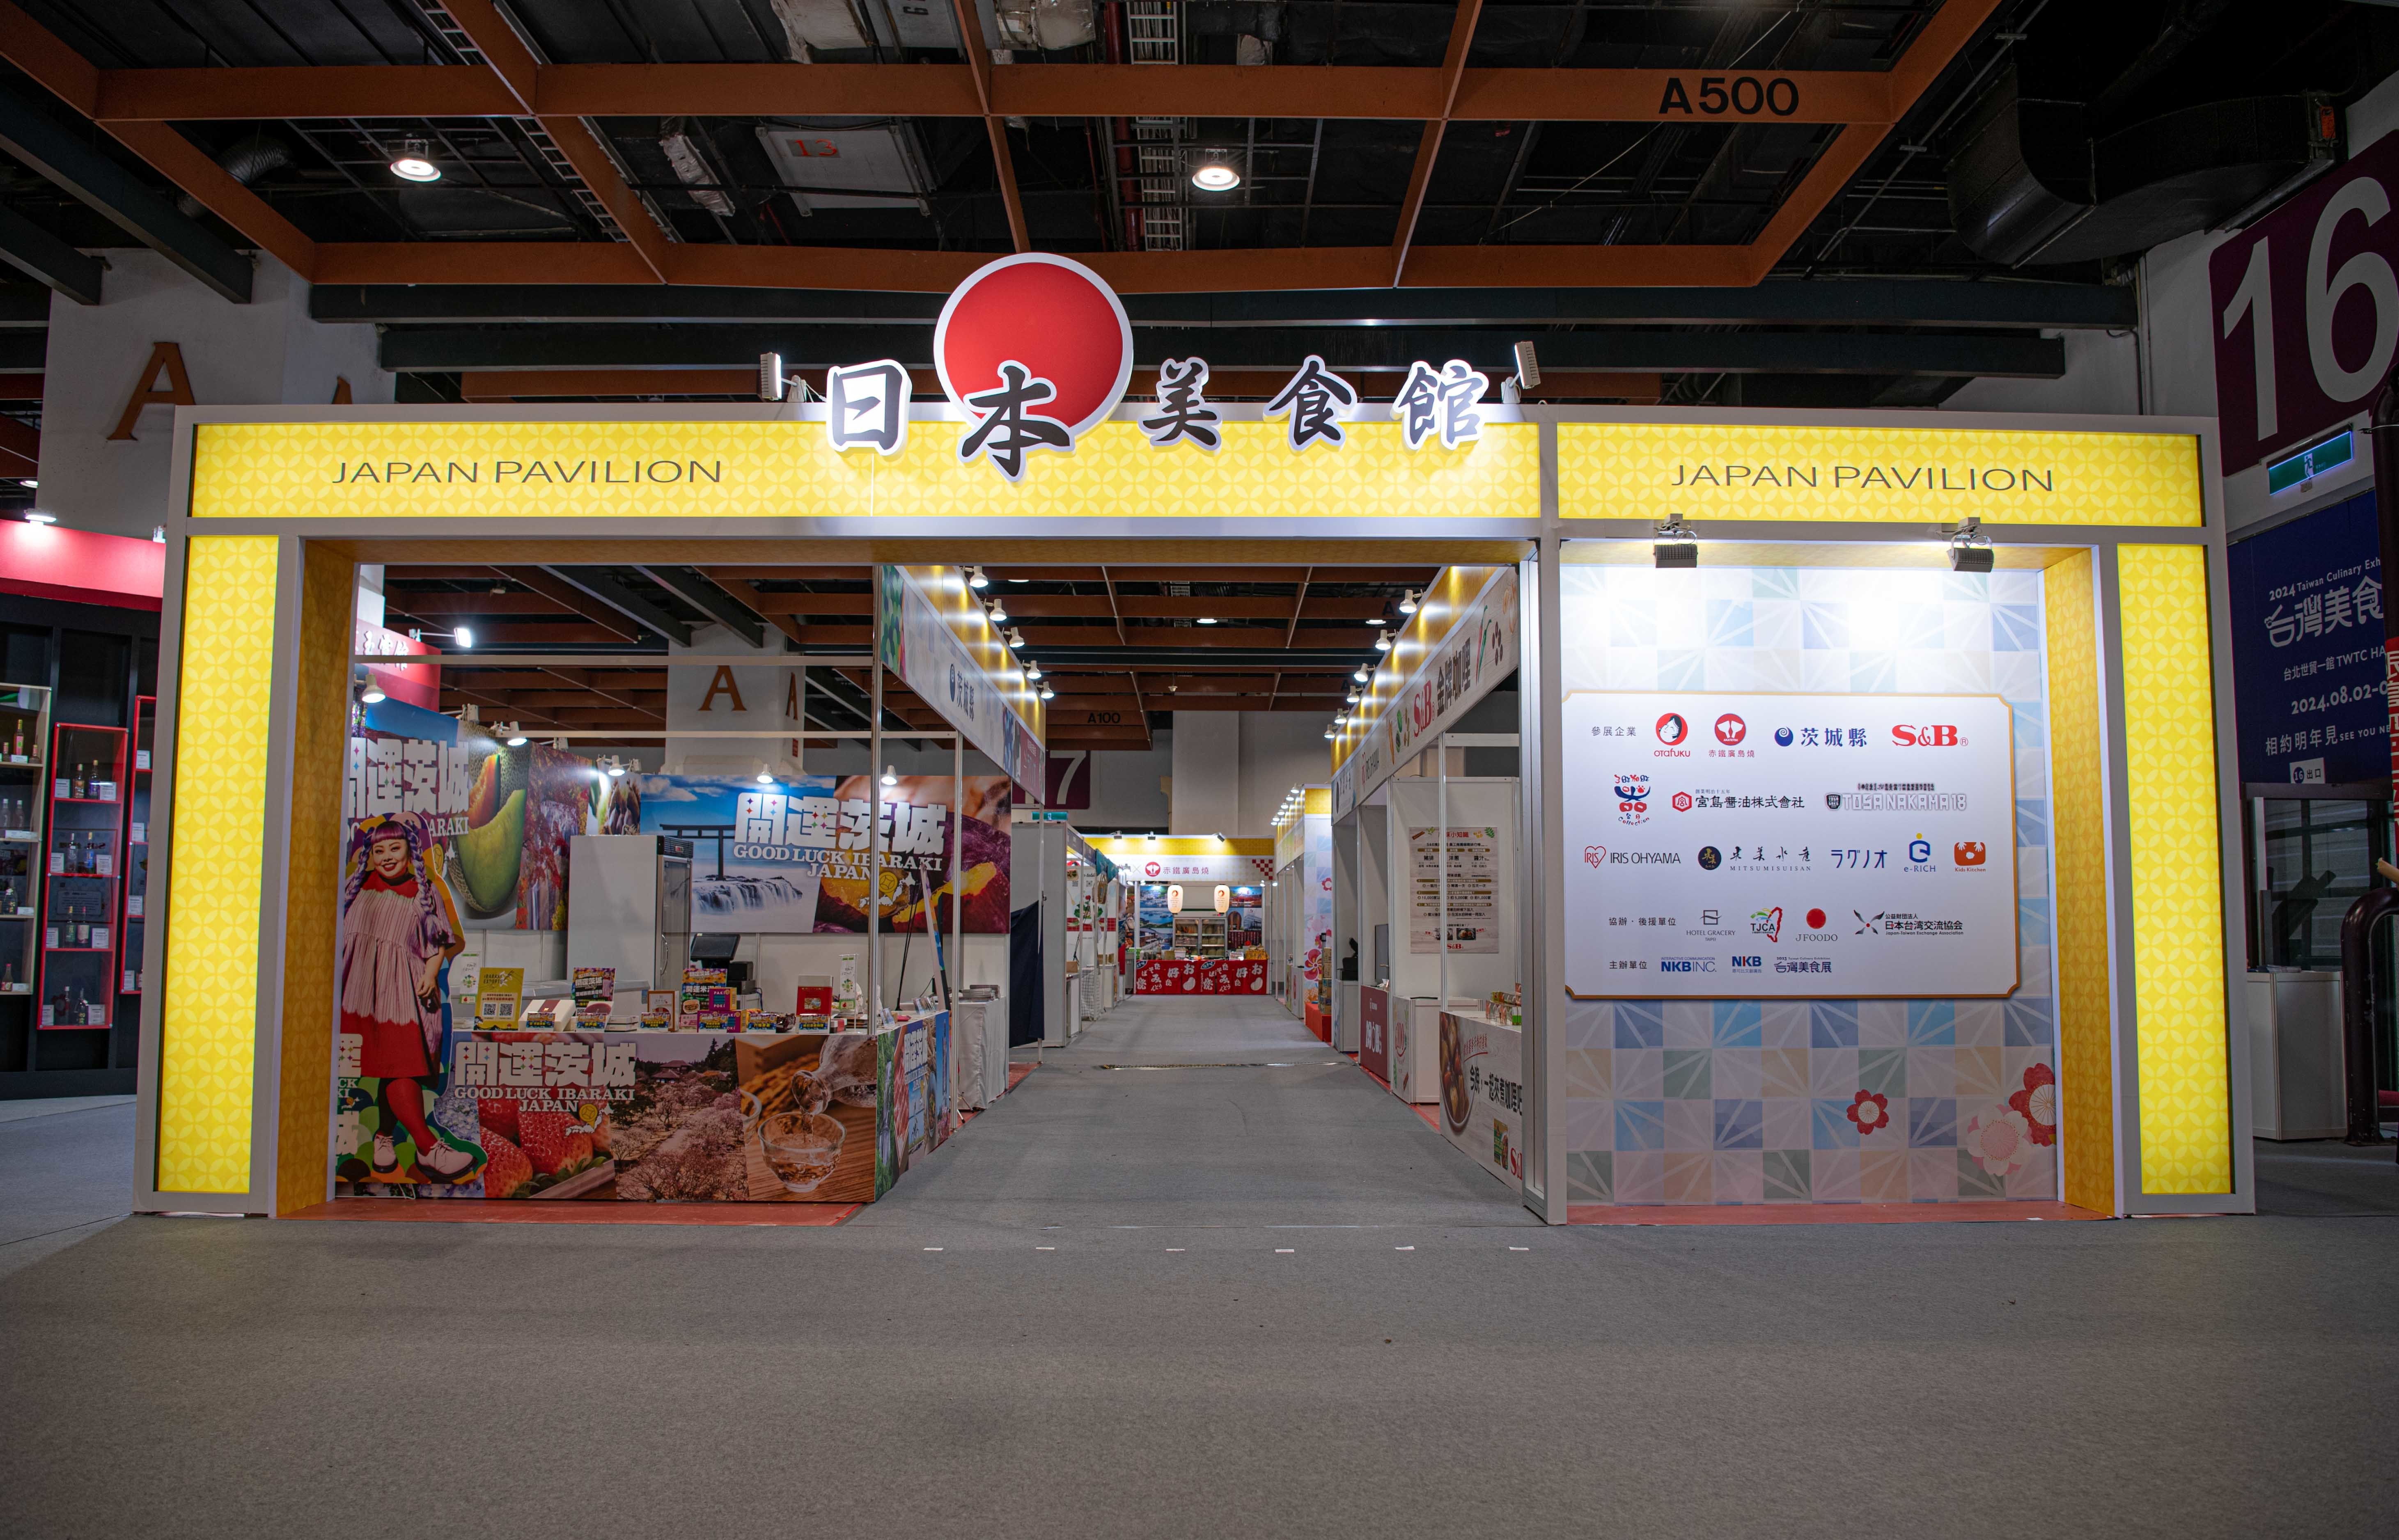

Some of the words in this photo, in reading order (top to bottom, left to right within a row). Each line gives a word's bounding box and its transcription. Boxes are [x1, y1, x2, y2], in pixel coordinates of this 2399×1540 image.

[1658, 77, 1799, 116] A500
[2223, 176, 2399, 441] 16
[829, 356, 1485, 479] 日本美食館
[332, 462, 478, 484] JAPAN
[495, 461, 721, 483] PAVILION
[1672, 465, 1817, 488] JAPAN
[1834, 466, 2053, 492] PAVILION
[2268, 584, 2295, 601] 2024
[2297, 577, 2324, 592] Taiwan
[2326, 565, 2362, 582] Culinary
[2284, 656, 2335, 681] 台北世貿一館
[2336, 650, 2368, 667] TWTC
[1087, 712, 1121, 724] A100
[1591, 726, 1636, 736] 參展企業
[1800, 727, 1867, 747] 茨城縣
[2265, 725, 2338, 756] 相約明年見
[2340, 731, 2355, 741] SEE
[2358, 728, 2376, 738] YOU
[1708, 749, 1755, 758] 赤鐵廣島燒
[2293, 771, 2304, 781] 16
[2306, 768, 2321, 780] 出口
[1842, 794, 1883, 811] TOSA
[1886, 794, 1950, 811] NAKAMA
[1951, 793, 1967, 811] 18
[733, 844, 790, 860] GOOD
[792, 848, 845, 865] LUCK
[1610, 852, 1628, 864] IRIS
[1631, 852, 1681, 864] OHYAMA
[1831, 849, 1888, 869] ラグノオ
[1750, 923, 1775, 932] TJCA
[1885, 921, 1963, 930] 日本台湾交流協会
[1796, 934, 1838, 942] JFOODO
[1609, 960, 1647, 969] 主辦單位
[1732, 956, 1762, 967] NKB
[1774, 961, 1832, 973] 台灣美食展
[454, 1041, 637, 1087] 開運茨城
[454, 1087, 503, 1099] GOOD
[505, 1087, 551, 1100] LUCK
[557, 1089, 635, 1100] IBARAKI
[519, 1100, 579, 1112] JAPAN
